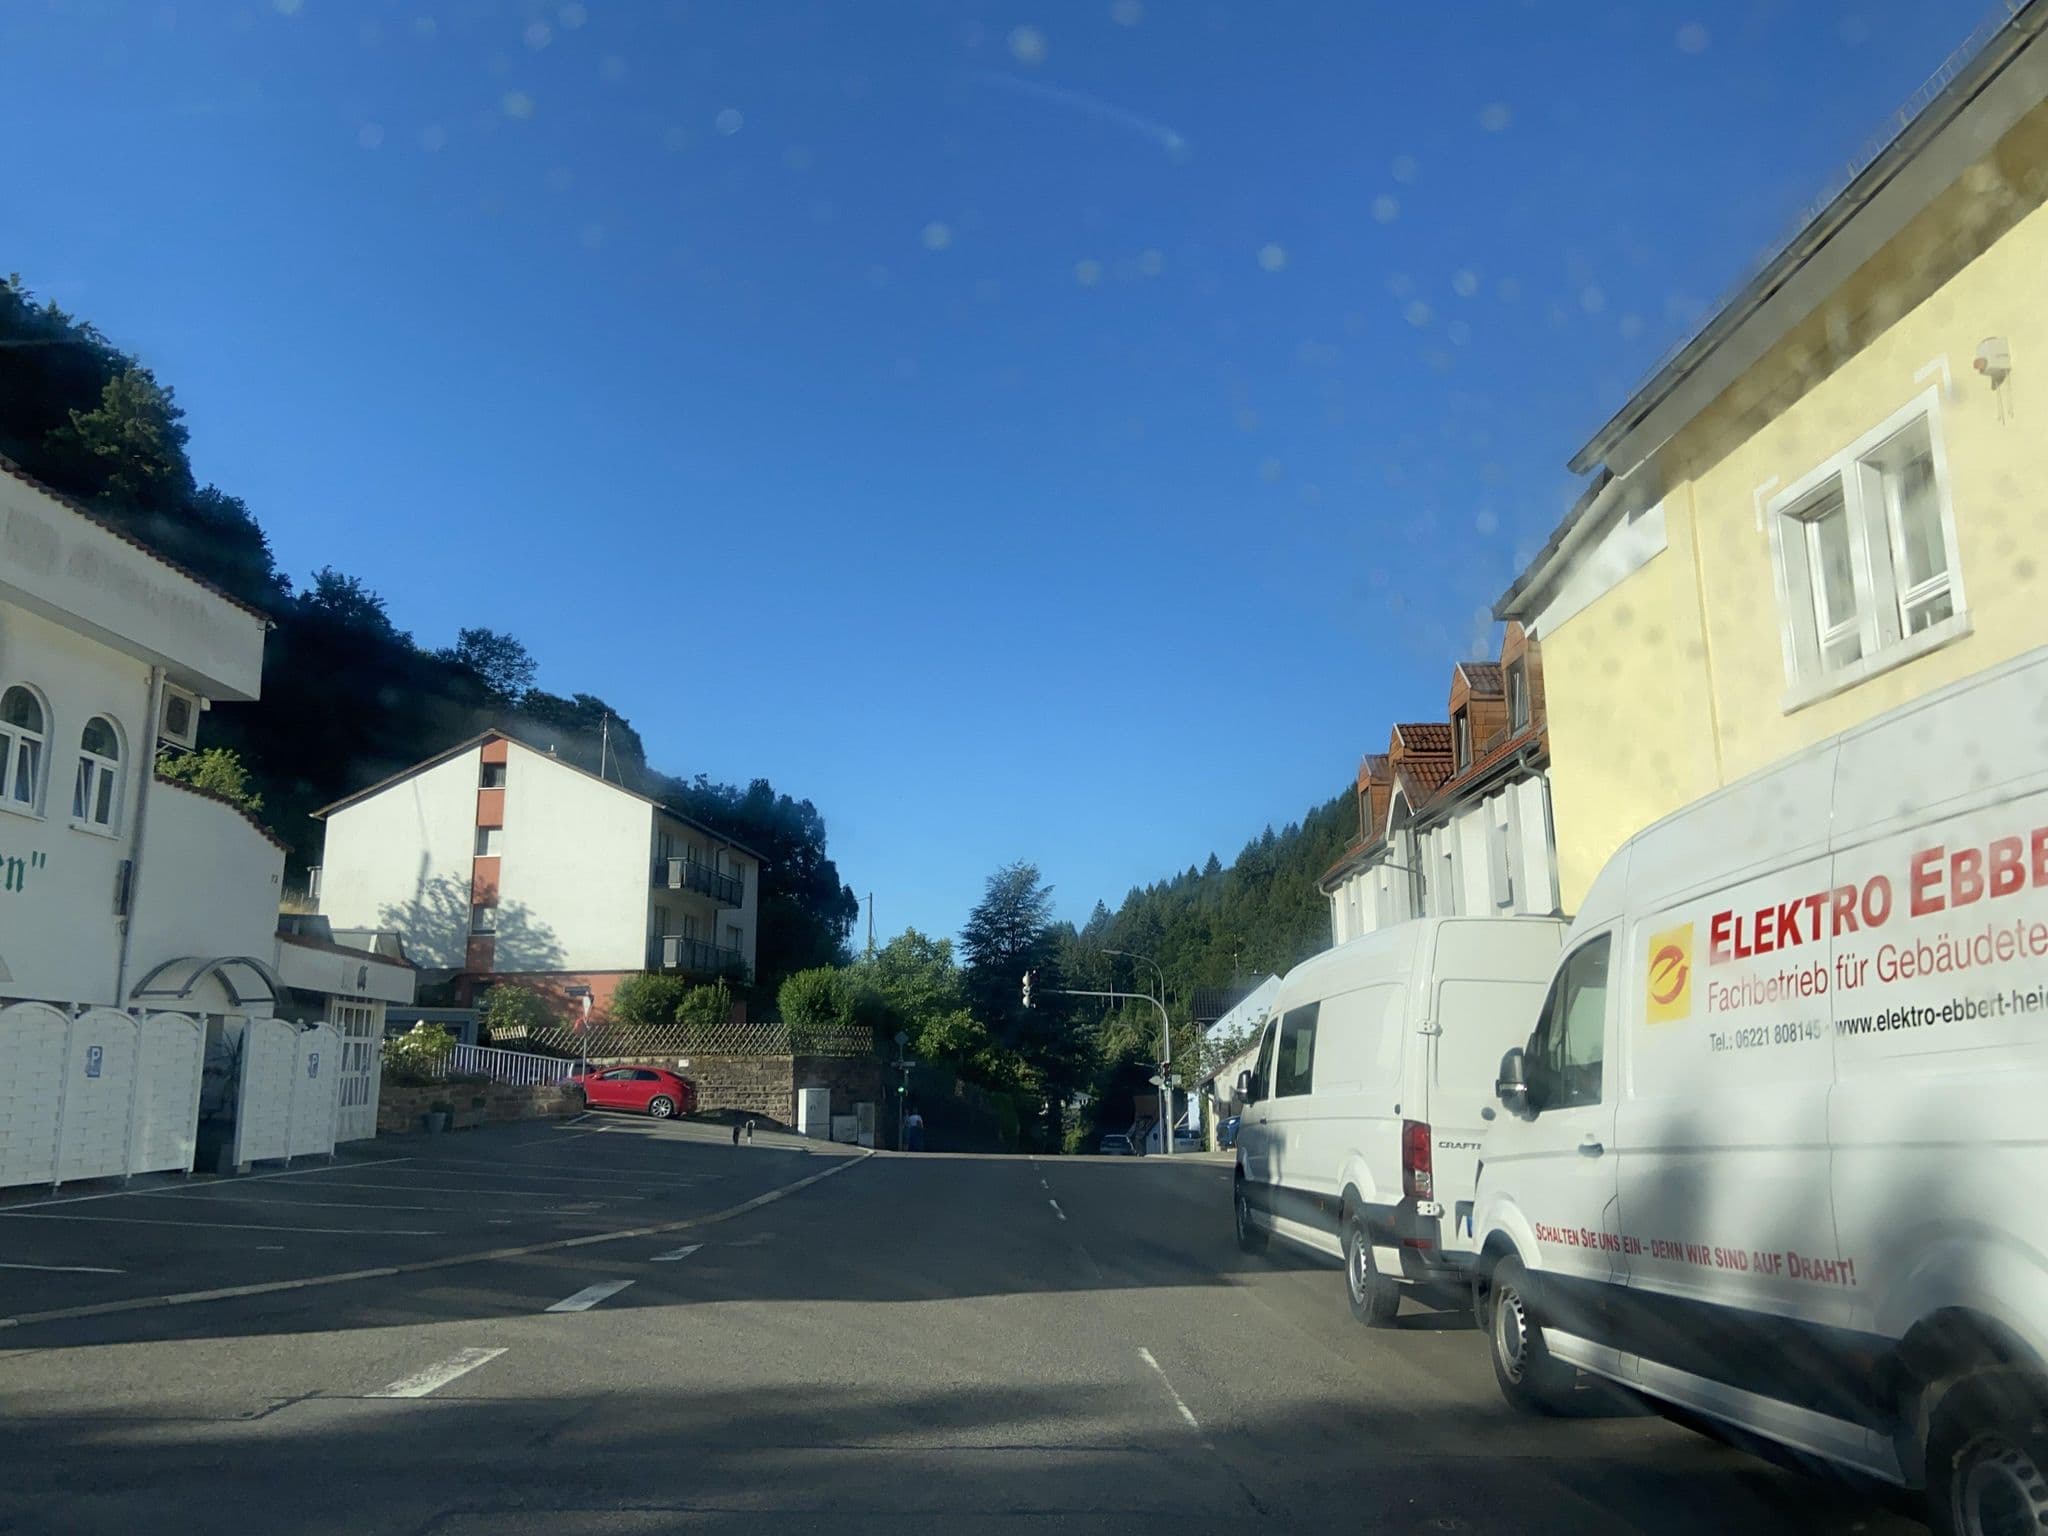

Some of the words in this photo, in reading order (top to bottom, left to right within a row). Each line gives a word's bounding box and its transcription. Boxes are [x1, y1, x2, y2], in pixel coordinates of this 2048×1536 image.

[1709, 875, 1892, 966] ELEKTRO
[1708, 960, 1828, 1013] Fachbetrieb
[1835, 953, 1868, 990] für
[1877, 919, 2048, 983] Gebäudete
[1736, 1026, 1769, 1048] 06221
[1835, 985, 2048, 1036] www.elektro-ebbert-hei
[91, 1047, 100, 1066] P
[1535, 1222, 1580, 1247] SCHALTEN
[1581, 1228, 1598, 1249] SIE
[1599, 1232, 1620, 1252] UNS
[1651, 1239, 1684, 1262] DENN
[1685, 1242, 1712, 1266] WIR
[1714, 1247, 1748, 1271] SIND
[1753, 1251, 1783, 1276] AUF
[1787, 1250, 1857, 1286] DRAHT!
